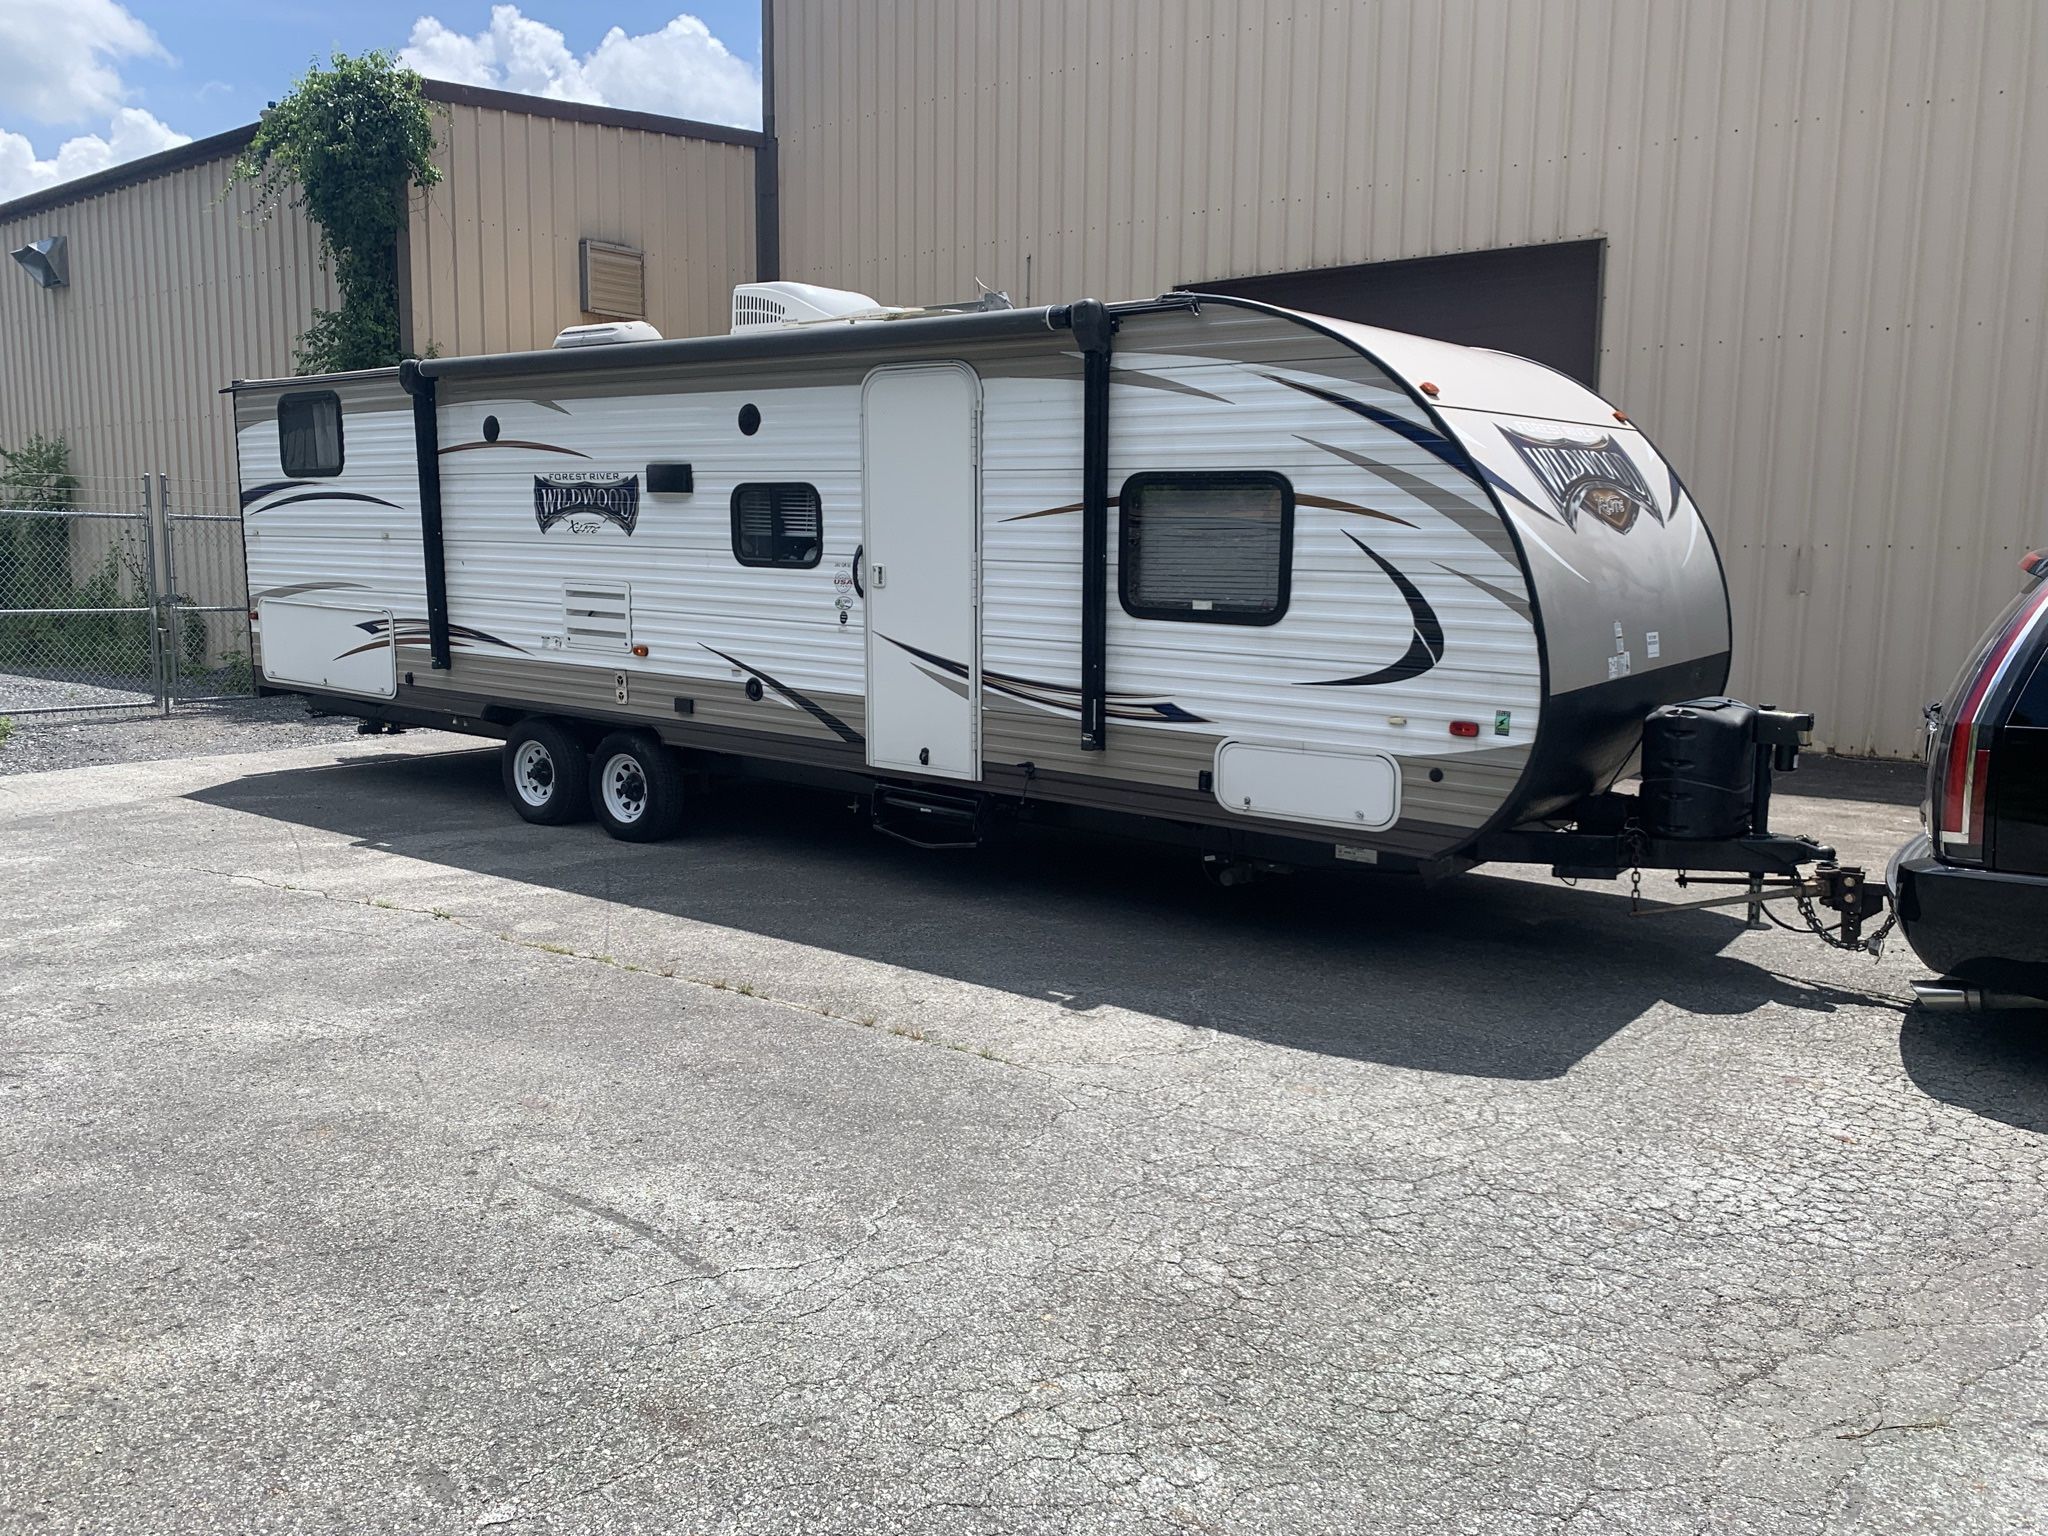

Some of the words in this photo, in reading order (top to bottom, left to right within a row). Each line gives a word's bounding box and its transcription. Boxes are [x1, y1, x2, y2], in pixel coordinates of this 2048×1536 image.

[589, 472, 620, 480] RIVER
[1522, 447, 1646, 499] WILDWOOD
[541, 489, 630, 517] WILDWOOD
